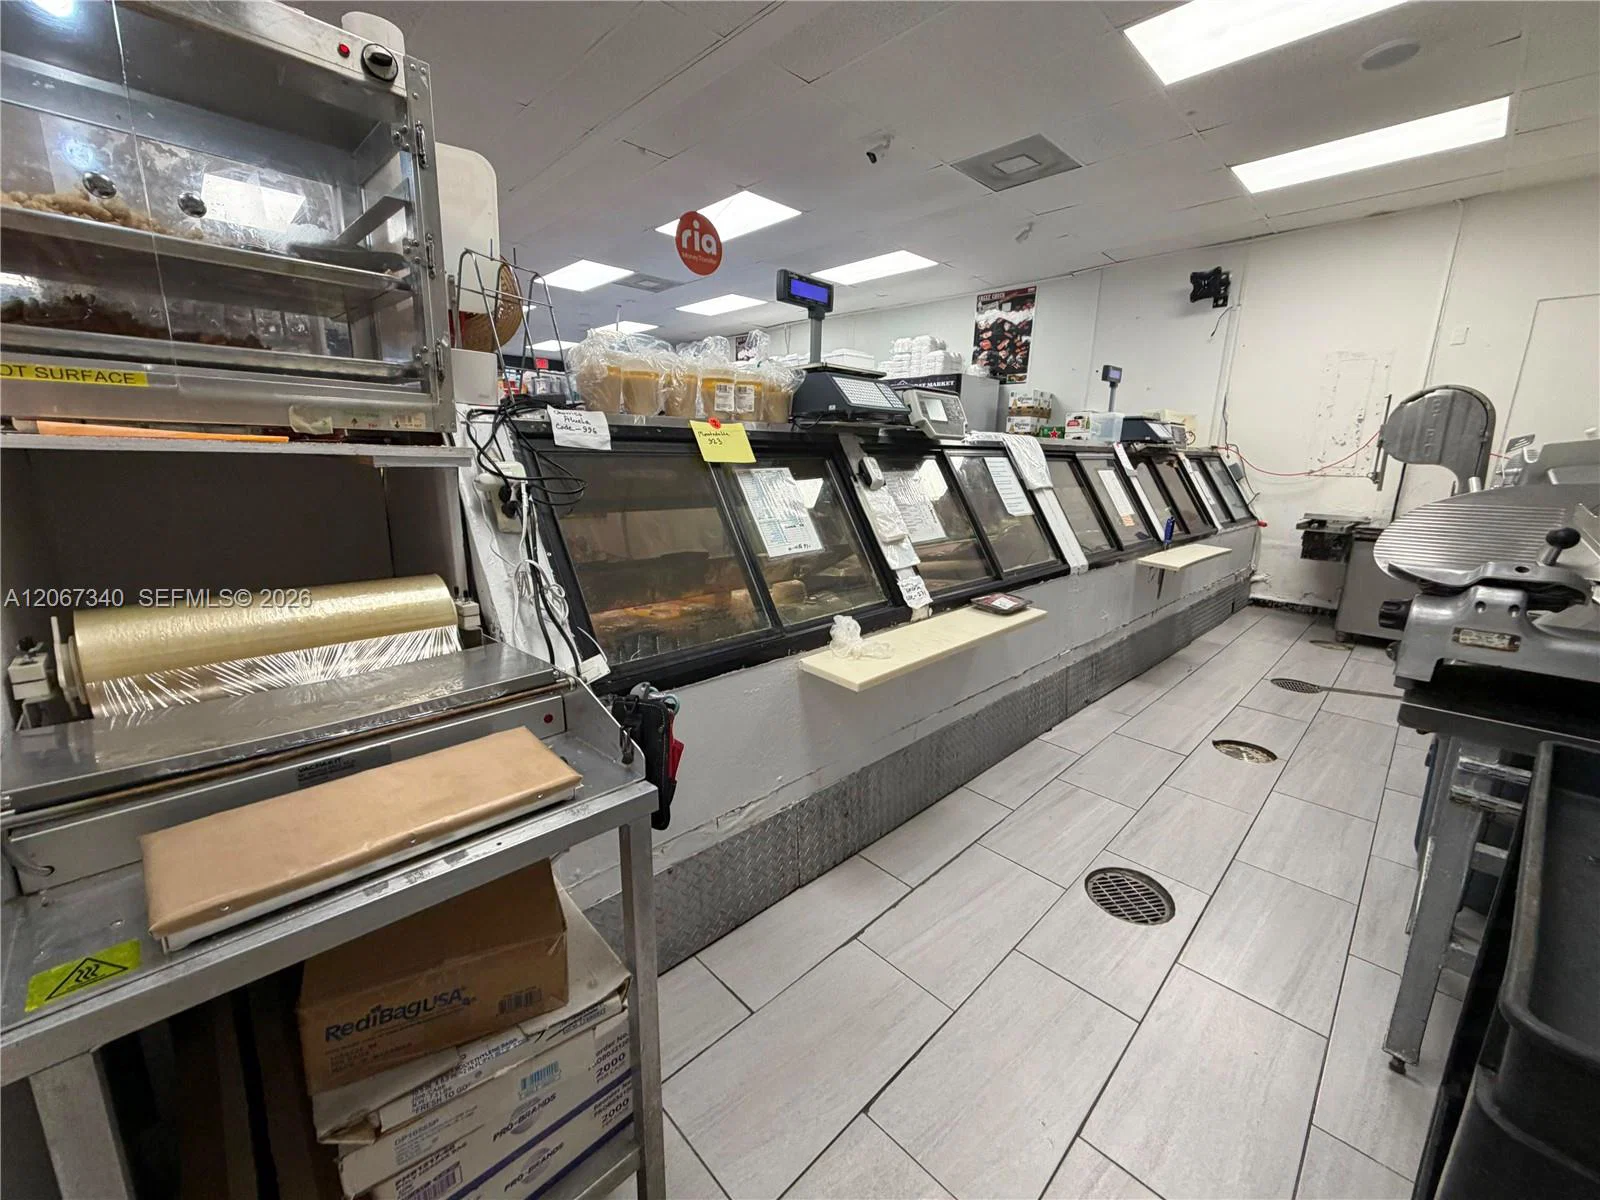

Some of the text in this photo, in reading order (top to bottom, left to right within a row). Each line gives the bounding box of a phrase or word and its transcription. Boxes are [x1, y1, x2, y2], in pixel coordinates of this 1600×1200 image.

[681, 219, 717, 256] ria
[0, 364, 137, 385] OT SURFACE
[325, 988, 463, 1043] RediBagUSA
[596, 1052, 626, 1078] 2000
[602, 1098, 630, 1124] 2000
